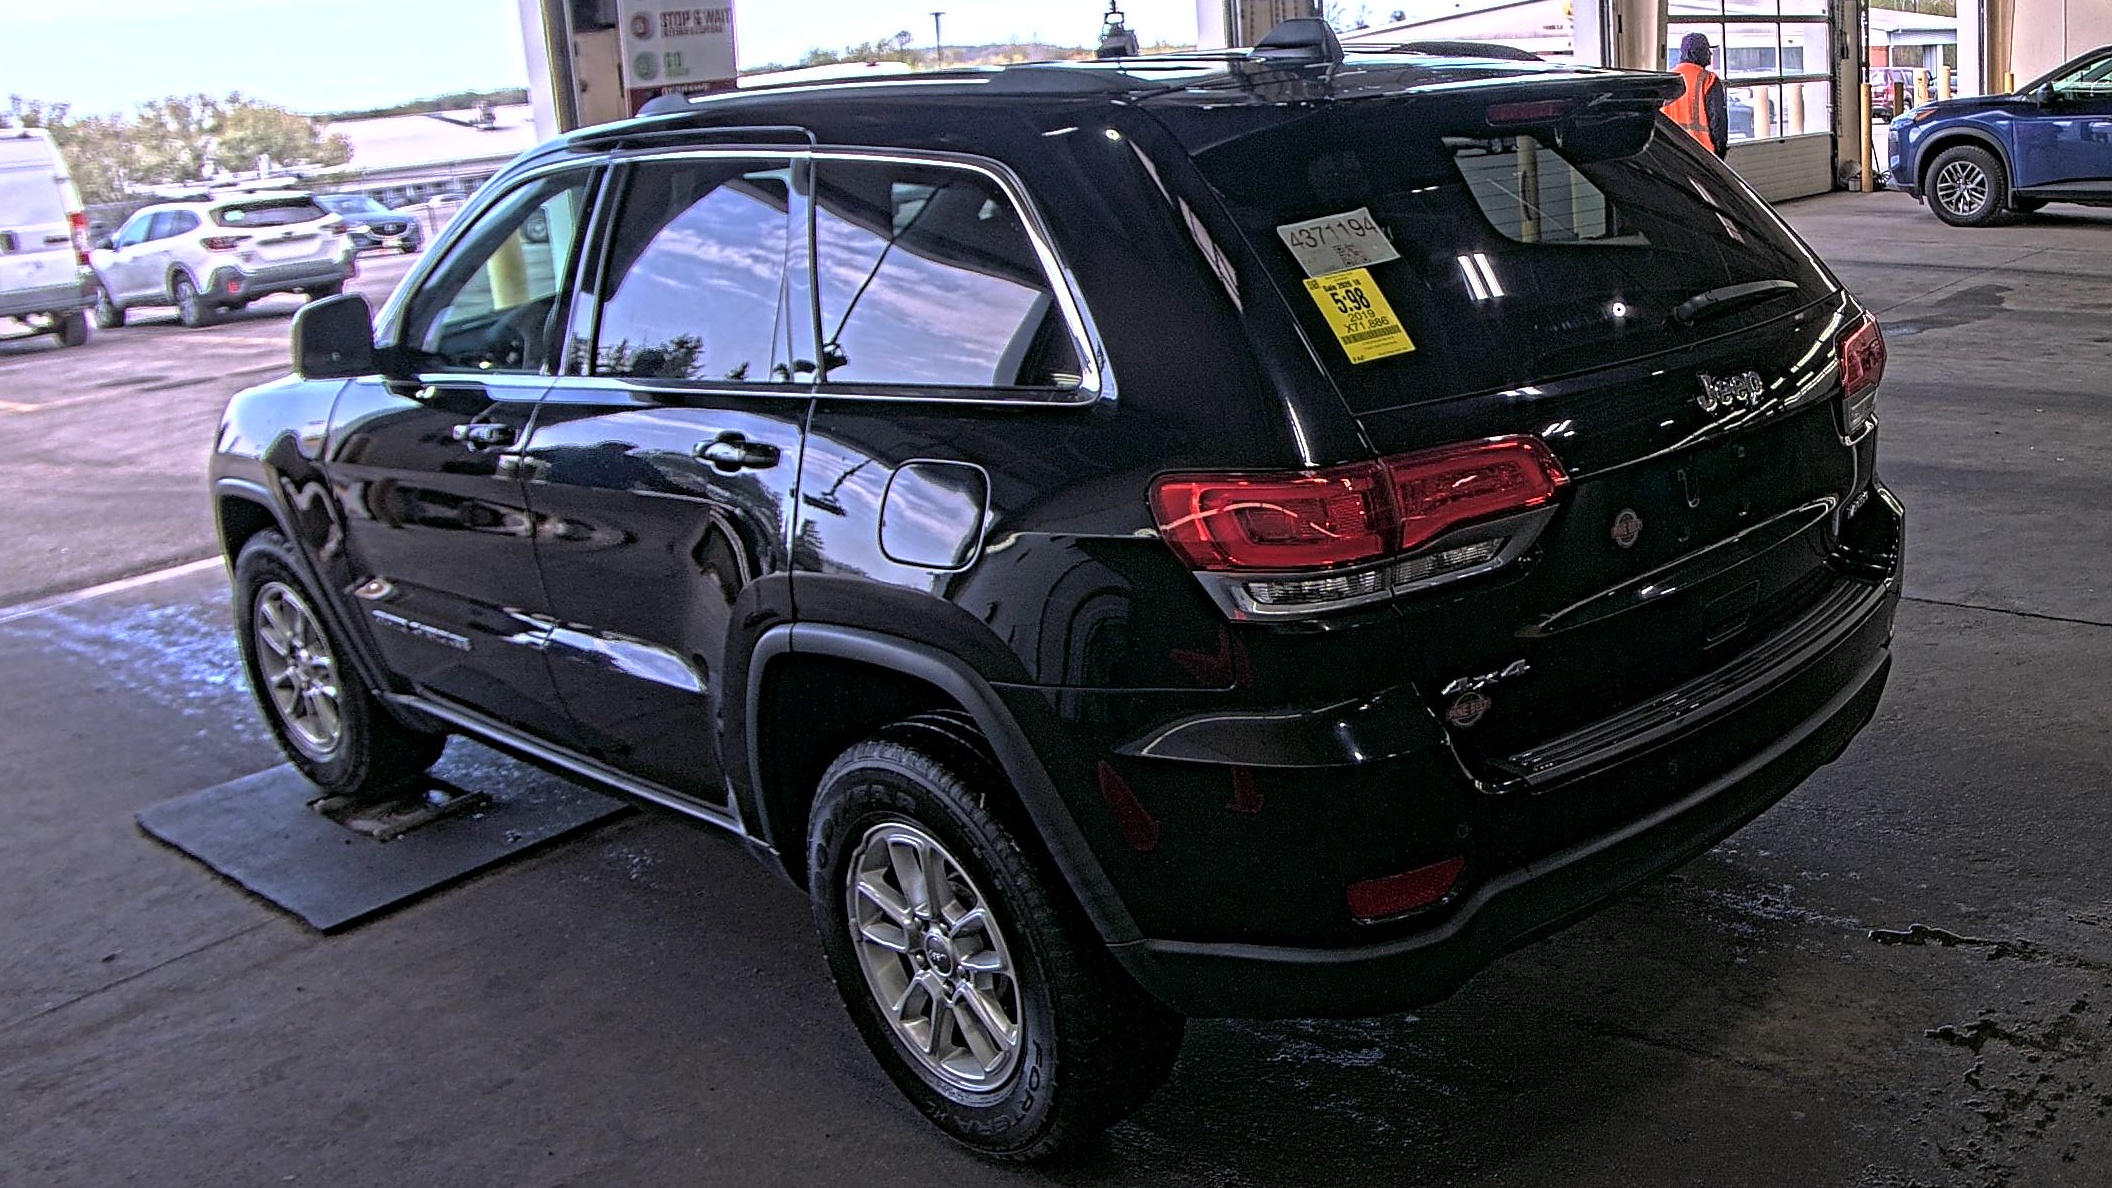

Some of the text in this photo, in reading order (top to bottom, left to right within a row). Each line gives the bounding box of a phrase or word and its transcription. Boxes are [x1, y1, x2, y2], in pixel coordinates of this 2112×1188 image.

[660, 8, 731, 27] STOP & WAIT
[1290, 216, 1379, 248] 4371194
[1348, 309, 1376, 323] 2019
[1696, 371, 1764, 412] Jeep
